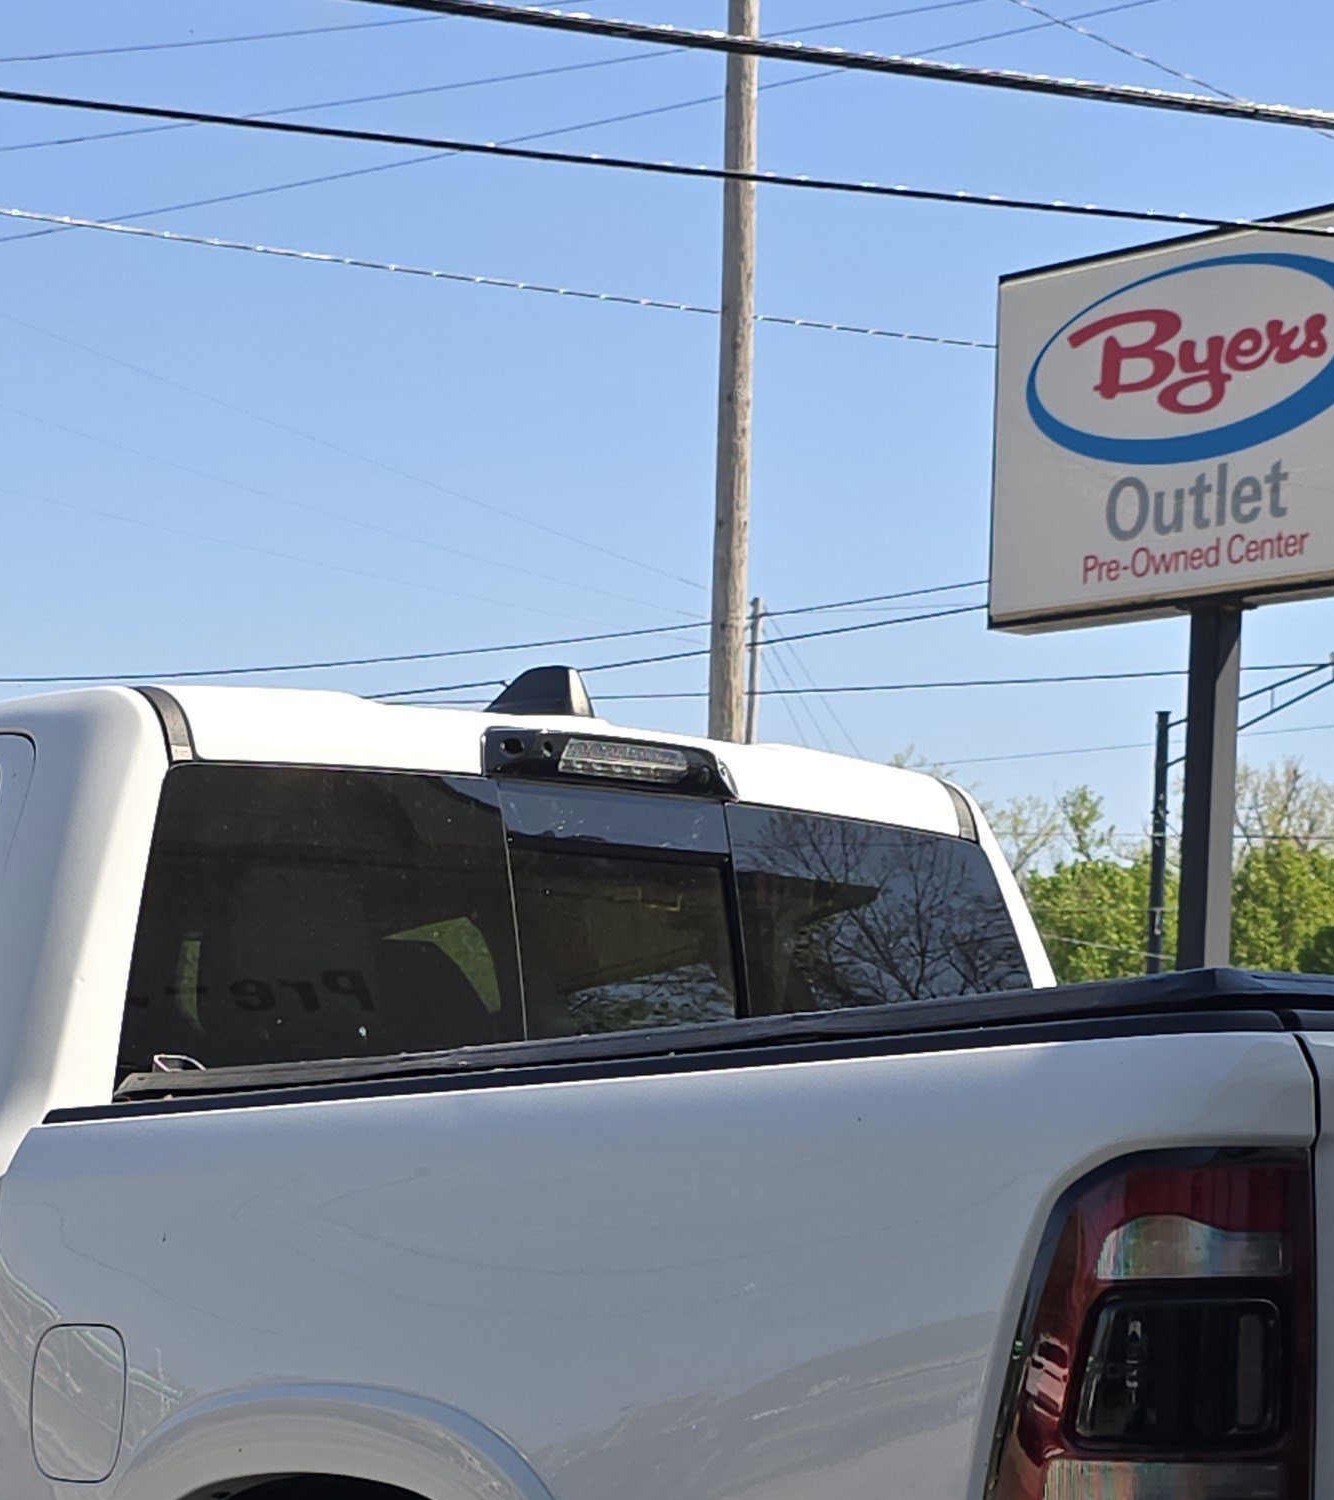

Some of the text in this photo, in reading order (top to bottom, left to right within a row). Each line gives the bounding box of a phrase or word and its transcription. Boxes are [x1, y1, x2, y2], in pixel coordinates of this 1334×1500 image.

[1067, 308, 1328, 415] Byers
[1106, 459, 1289, 542] Outlet
[1081, 530, 1310, 585] Pre-Owned Center
